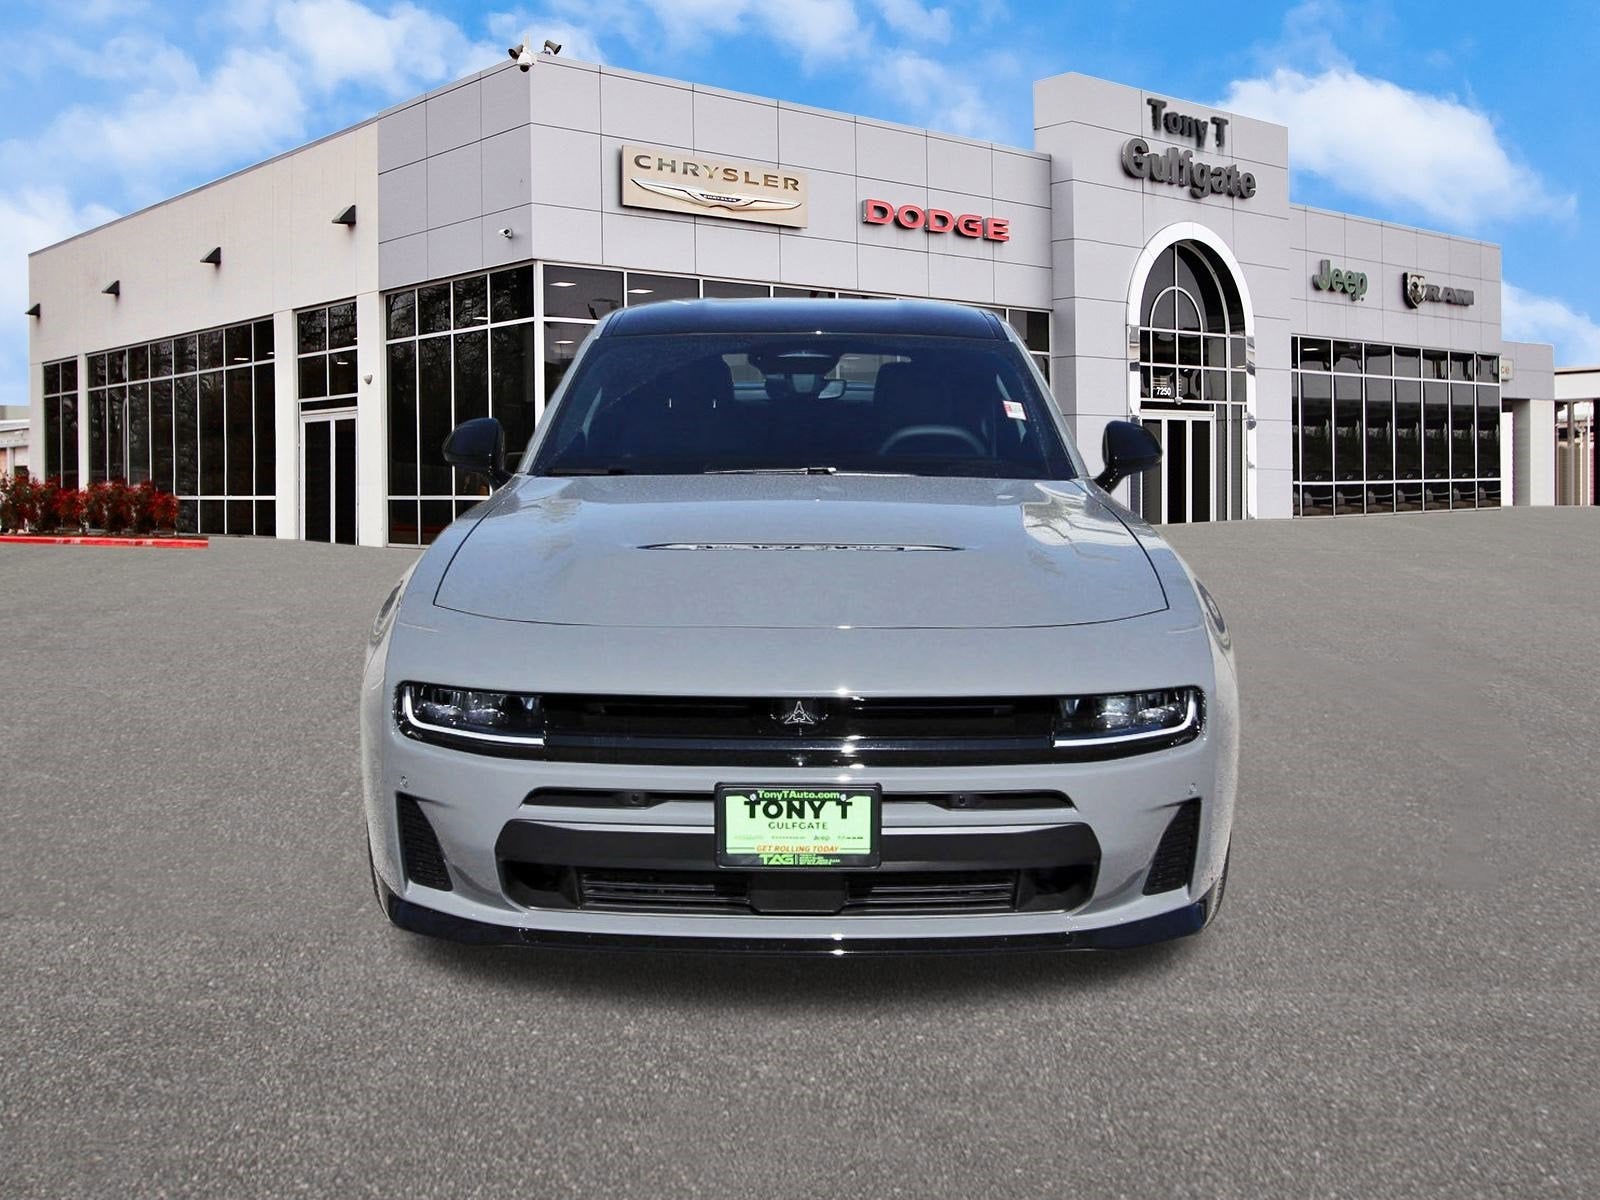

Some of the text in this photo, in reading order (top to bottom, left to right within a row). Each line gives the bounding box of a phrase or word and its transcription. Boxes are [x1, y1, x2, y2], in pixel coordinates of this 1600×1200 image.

[1147, 98, 1229, 148] Tony T
[633, 153, 801, 192] CHRYSLER
[1121, 138, 1257, 199] Gulfgate
[862, 199, 1010, 242] DODGE
[1312, 259, 1368, 301] Jeep
[1424, 283, 1474, 306] RAM
[1156, 386, 1171, 396] 7250
[744, 800, 853, 819] TONY T
[757, 790, 840, 800] TonyTAuto.com
[768, 821, 828, 830] GULFGATE
